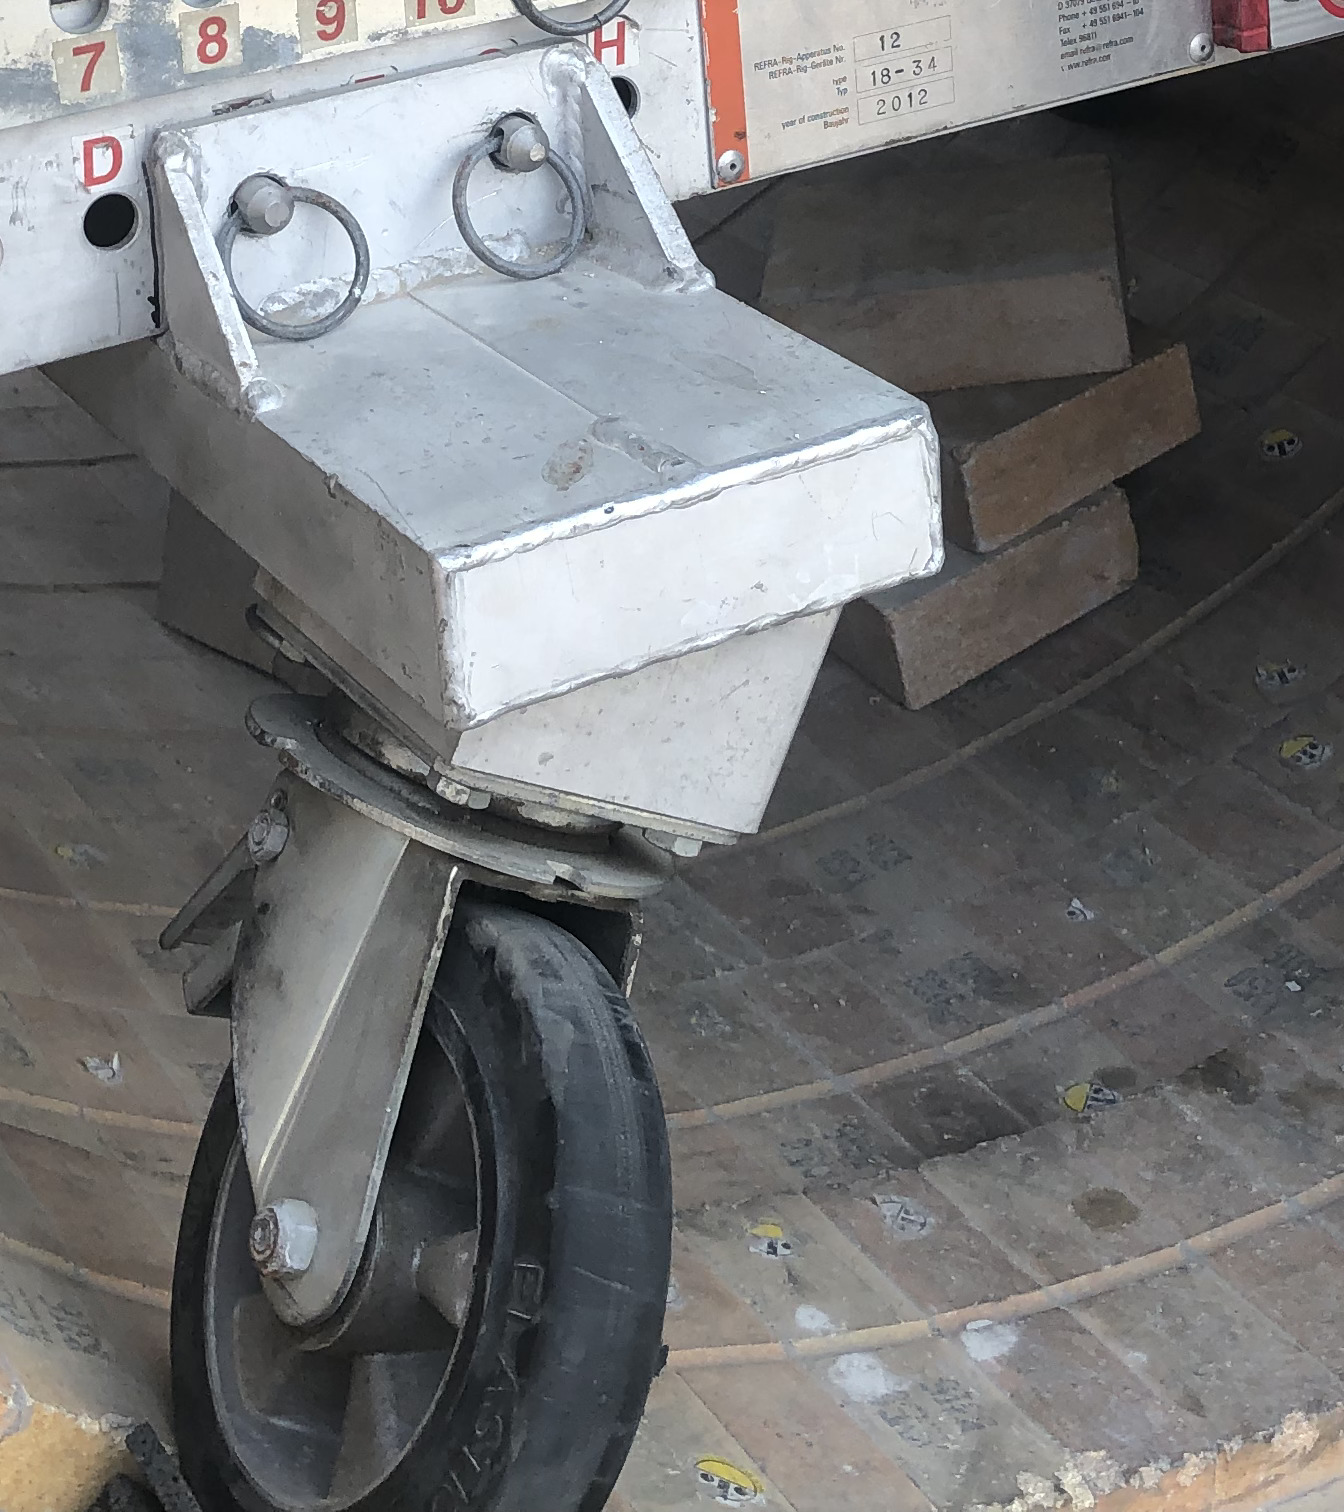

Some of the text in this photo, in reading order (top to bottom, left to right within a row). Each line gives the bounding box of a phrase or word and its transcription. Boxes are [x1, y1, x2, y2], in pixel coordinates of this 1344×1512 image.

[196, 16, 229, 65] 8
[592, 20, 626, 66] H
[879, 31, 901, 51] 12
[71, 41, 107, 93] 7
[876, 88, 929, 115] 2012
[83, 135, 123, 188] D
